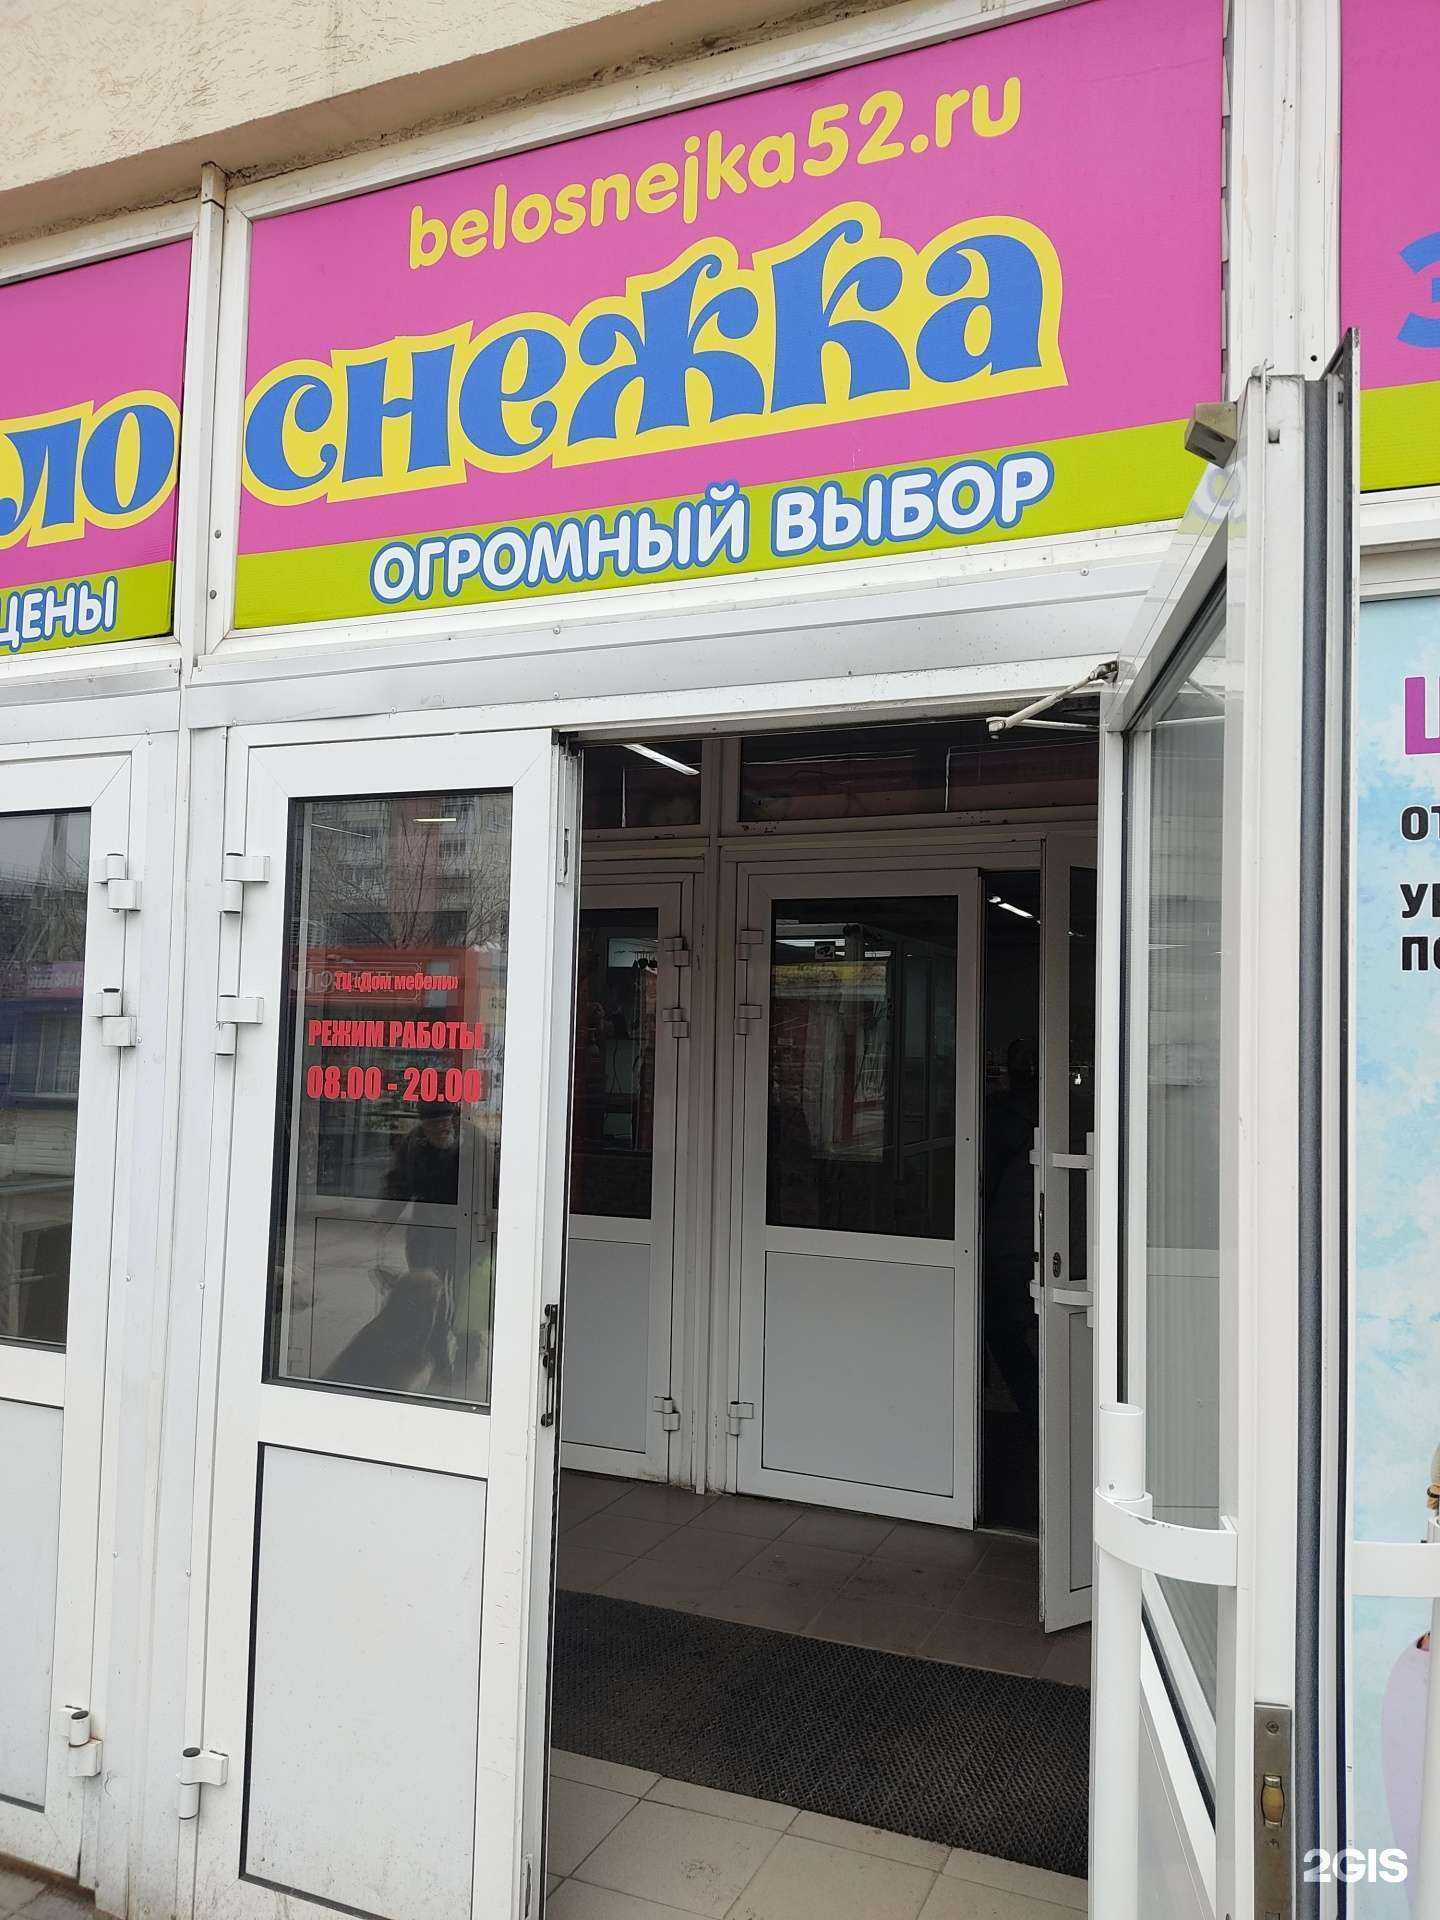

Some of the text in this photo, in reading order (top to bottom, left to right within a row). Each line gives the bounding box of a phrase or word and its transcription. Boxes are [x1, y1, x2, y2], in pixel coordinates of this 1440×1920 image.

[408, 76, 1022, 270] belosnejka52.ru
[371, 454, 1052, 603] ОГРОМНЫЙ ВЫБОР
[308, 1019, 483, 1050] РЕЖИМ РАБОТЫ
[306, 1065, 382, 1100] 08.00
[402, 1067, 482, 1104] 20.00
